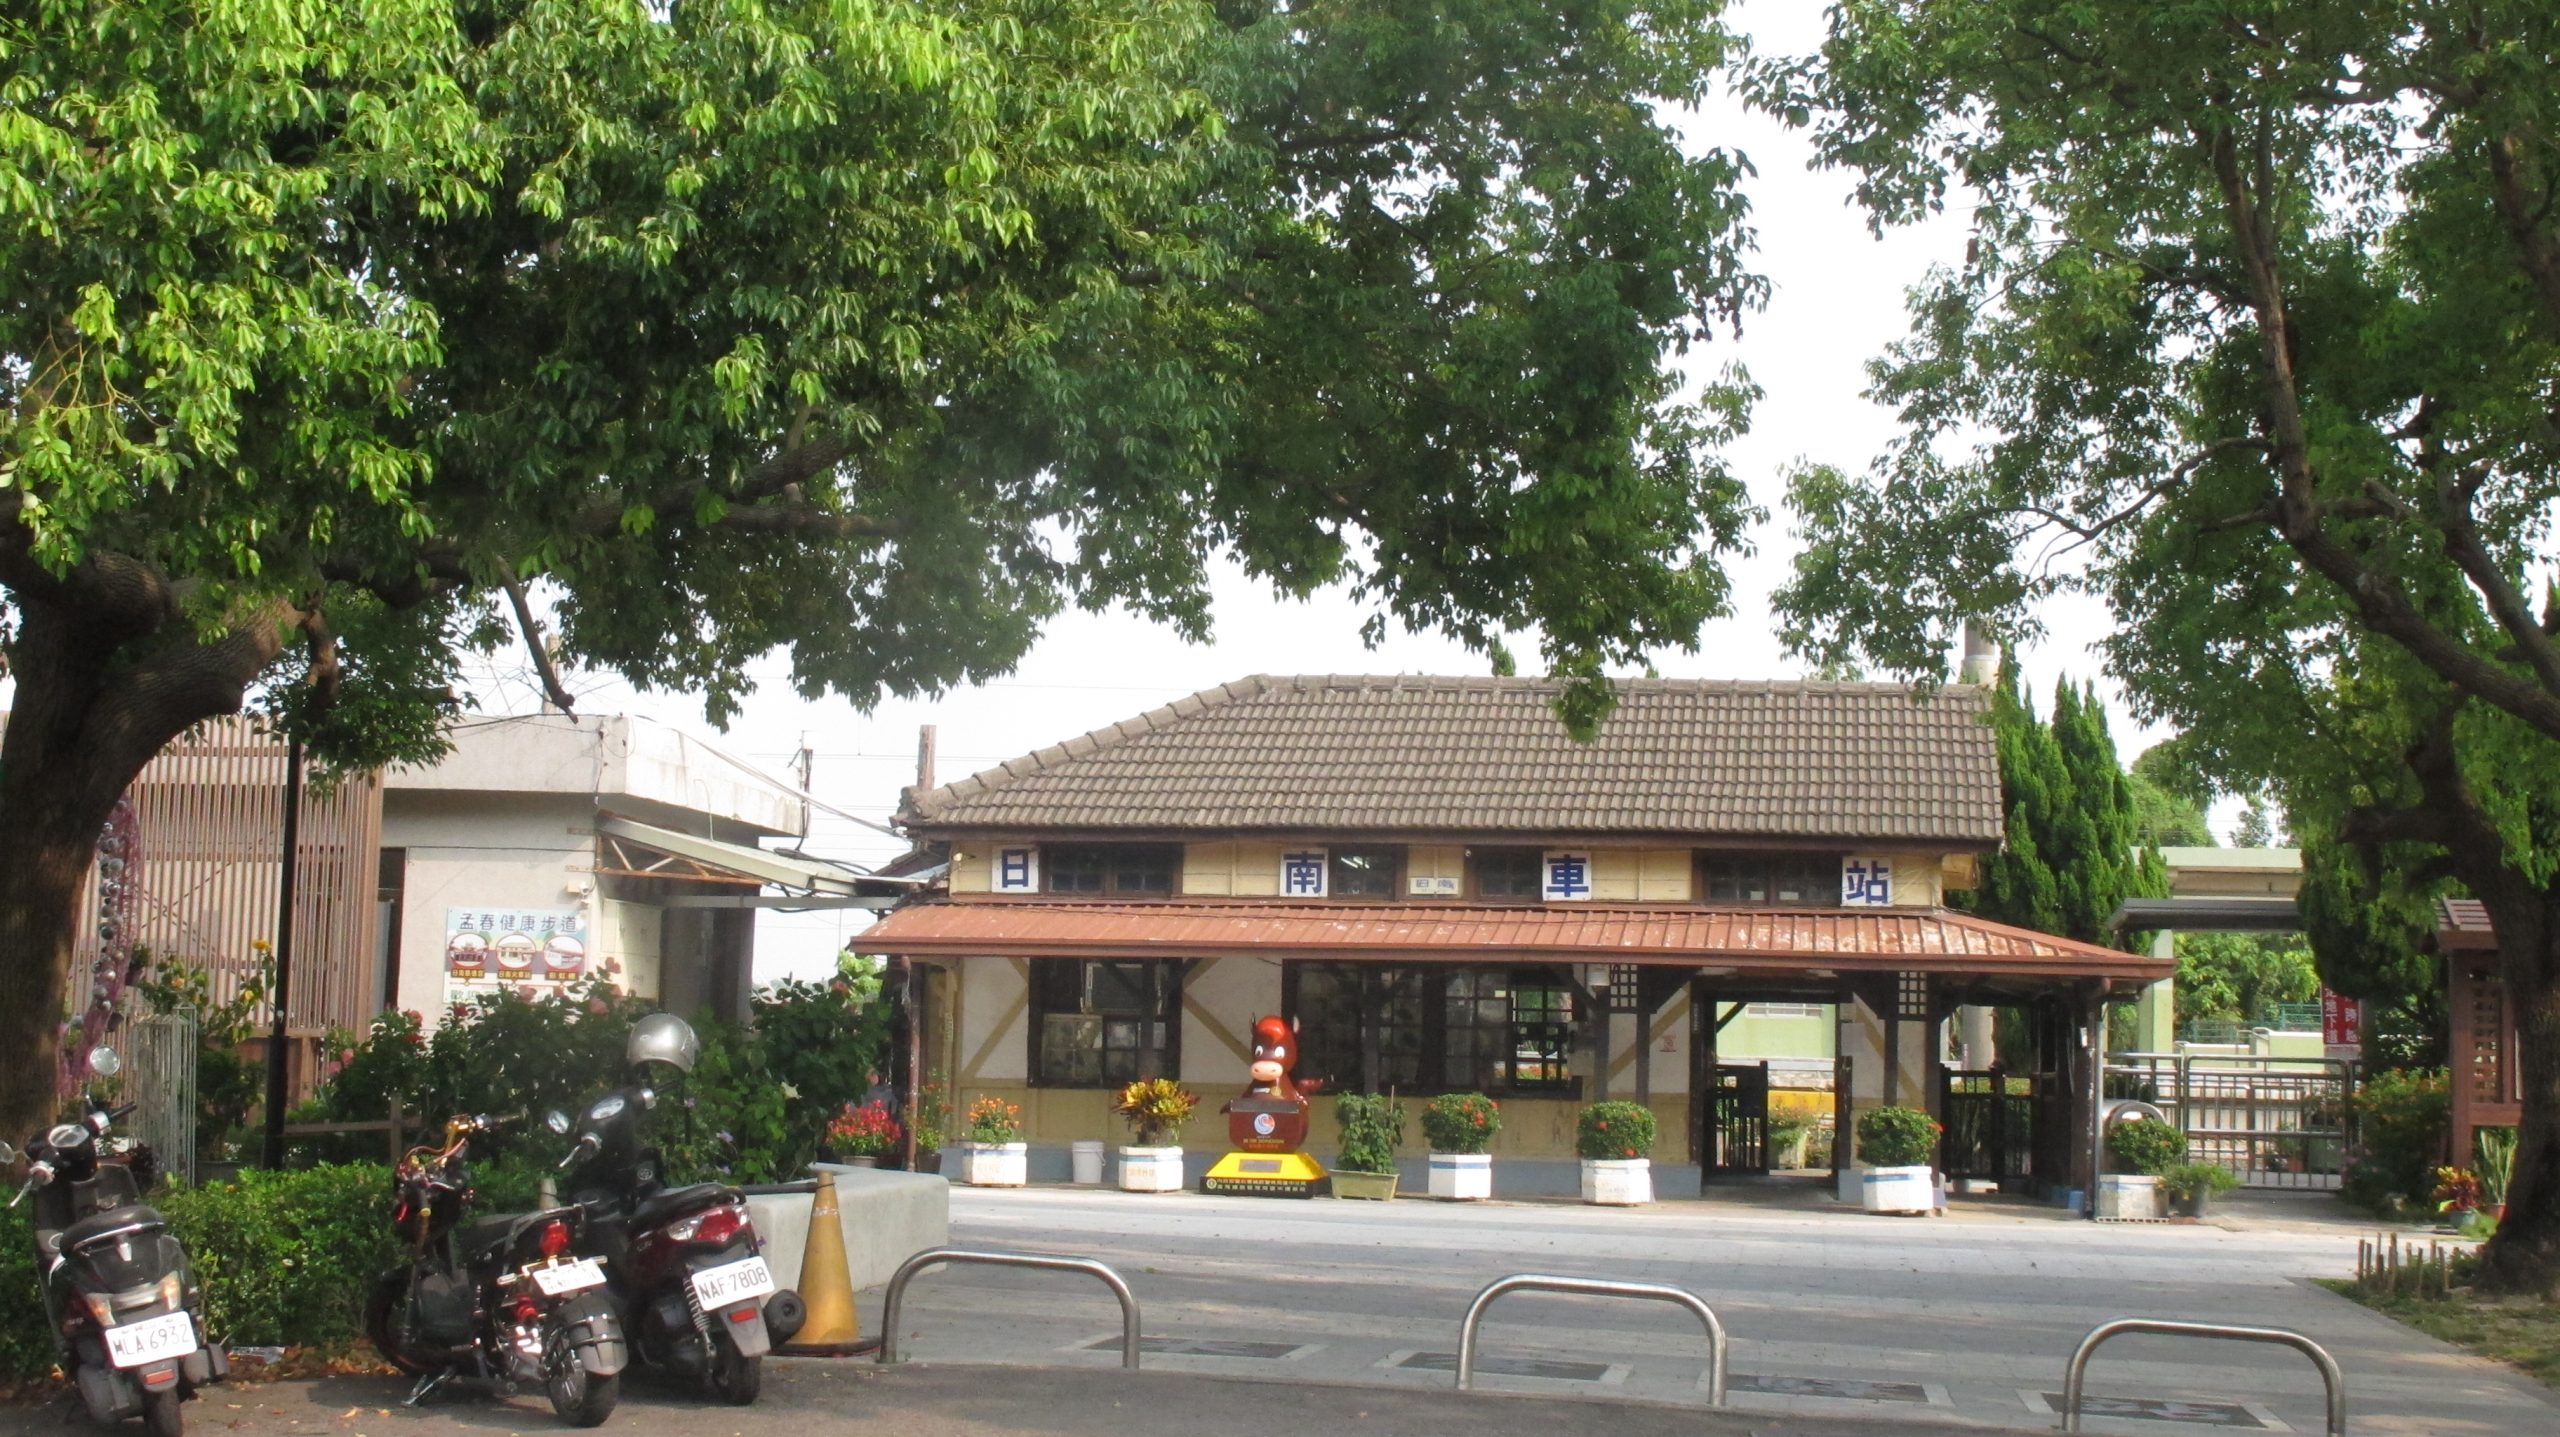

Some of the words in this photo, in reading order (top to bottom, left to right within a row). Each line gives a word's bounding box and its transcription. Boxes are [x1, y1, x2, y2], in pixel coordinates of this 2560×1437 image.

[1002, 850, 1028, 888] 日
[1283, 851, 1322, 894] 南
[1546, 854, 1590, 897] 車
[1846, 860, 1889, 904] 站
[459, 913, 577, 932] 孟春健康步道
